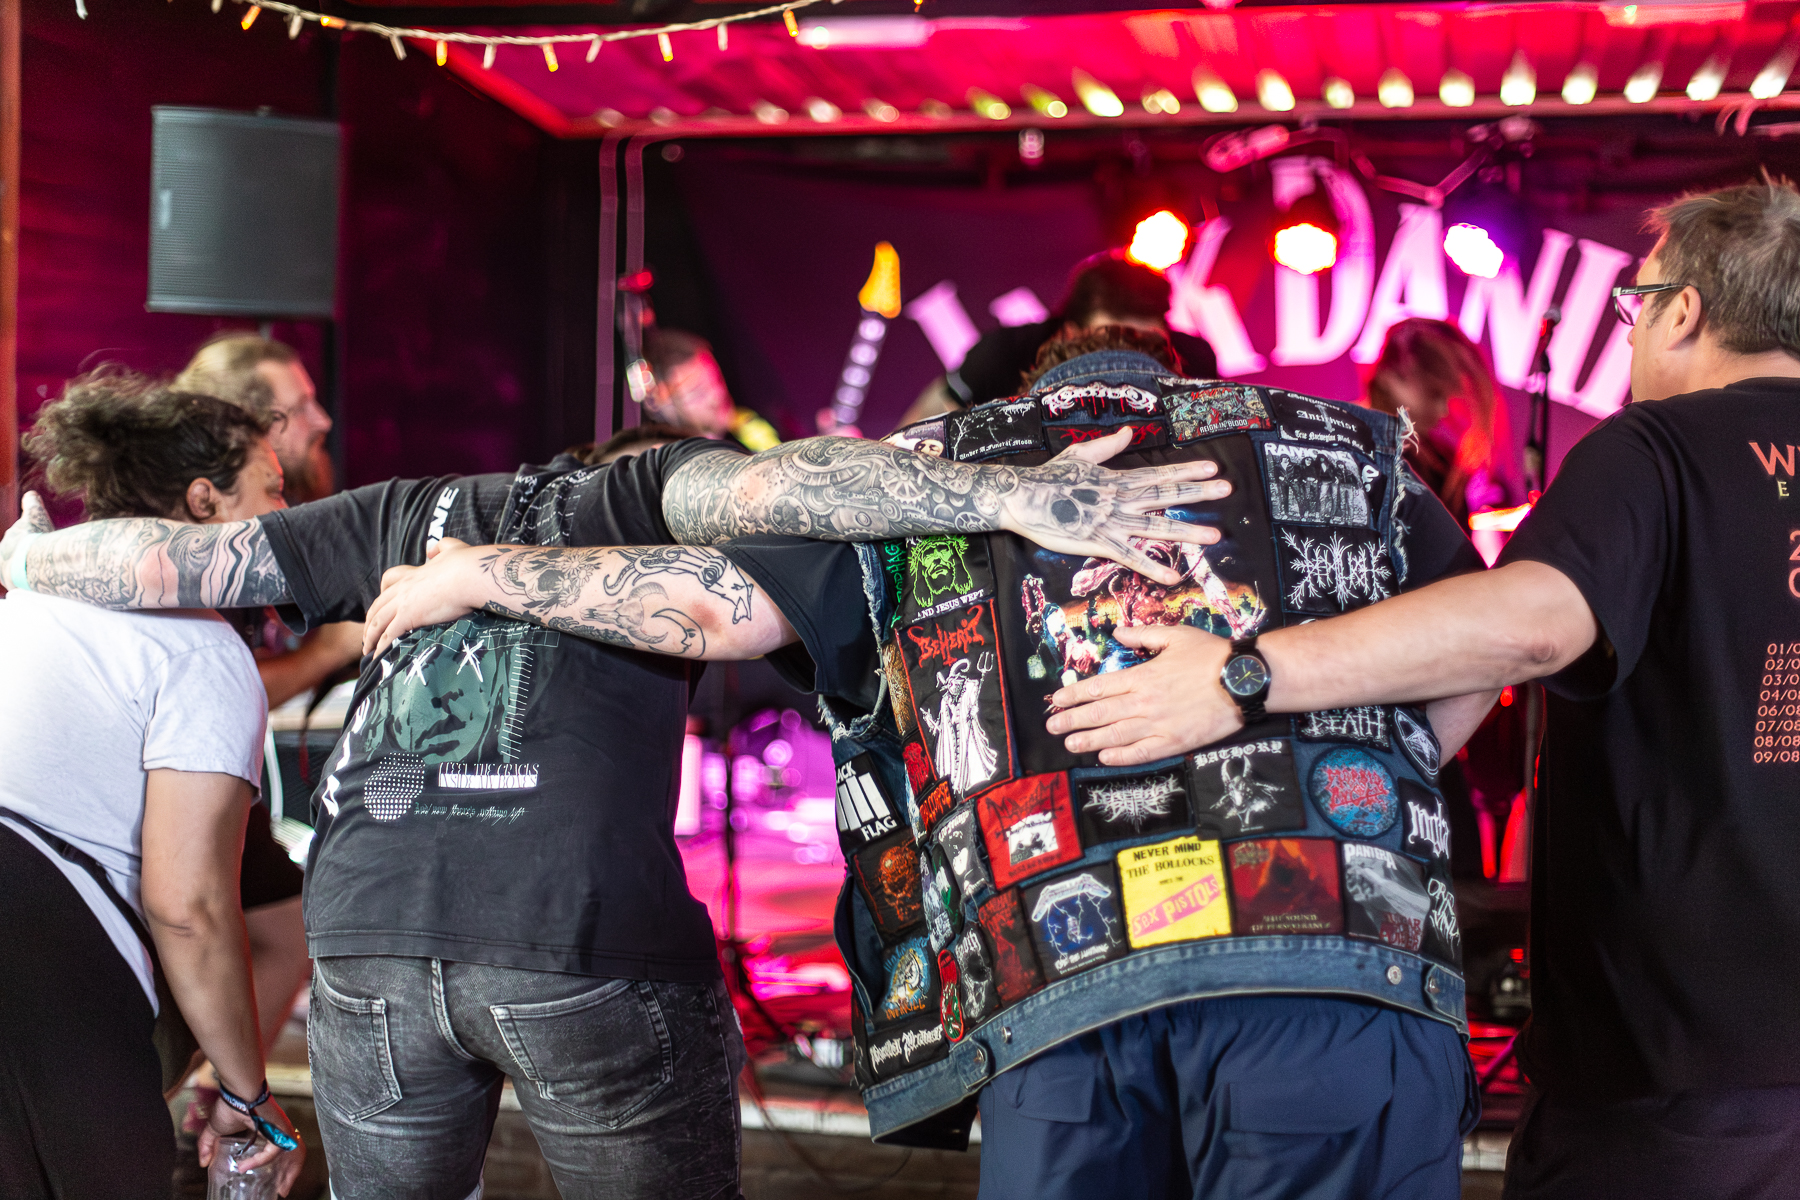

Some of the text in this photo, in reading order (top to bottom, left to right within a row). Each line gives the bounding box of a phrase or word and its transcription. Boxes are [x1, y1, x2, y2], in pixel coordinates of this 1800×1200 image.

[1200, 423, 1218, 433] REIGN
[1227, 419, 1248, 427] BLOOD
[935, 597, 960, 614] JESUS
[960, 589, 985, 604] WEPT
[1767, 643, 1800, 655] 01/0
[1764, 658, 1800, 671] 02/0
[1762, 673, 1800, 686] 03/0
[1760, 689, 1800, 701] 04/0
[1754, 735, 1800, 748] 08/08
[1194, 740, 1283, 769] BATHORY
[1753, 750, 1800, 763] 09/08
[836, 761, 857, 785] ACK
[860, 815, 898, 842] FLAG
[1133, 843, 1201, 861] NEVER MIND
[1343, 843, 1398, 870] PANTERA
[1126, 856, 1214, 879] THE BOLLOCKS
